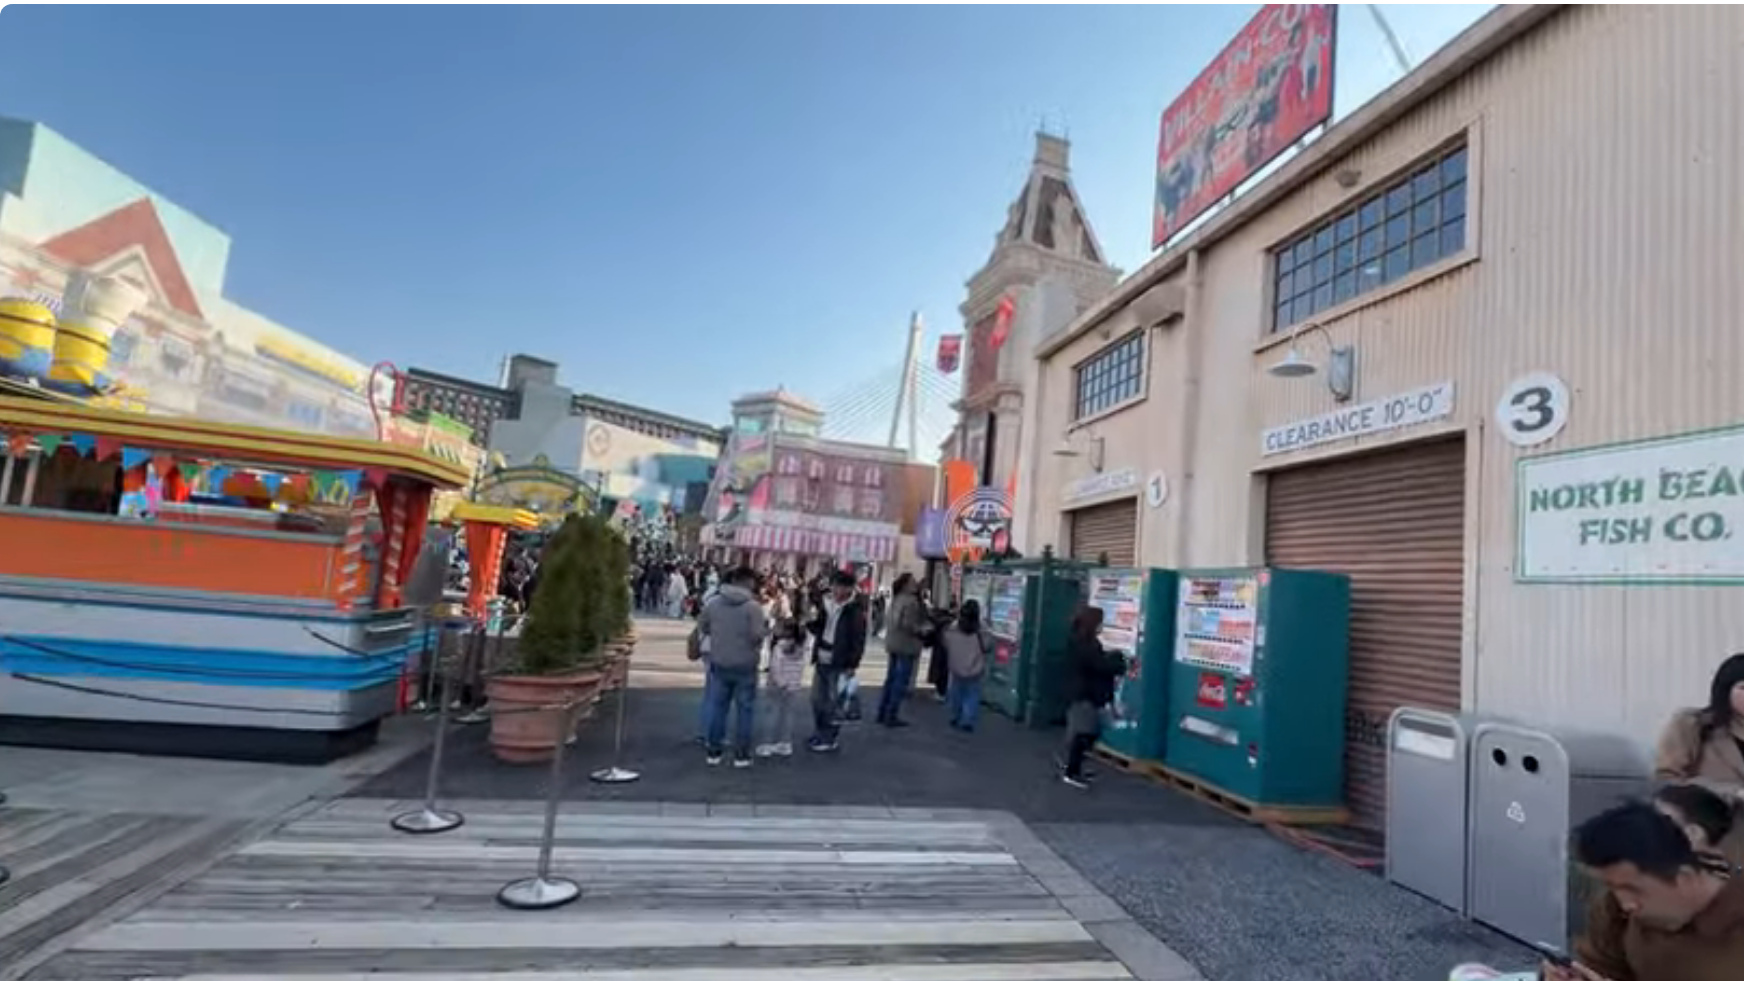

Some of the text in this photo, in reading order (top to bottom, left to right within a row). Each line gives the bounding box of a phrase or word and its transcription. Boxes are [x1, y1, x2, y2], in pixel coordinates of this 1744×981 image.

[1163, 4, 1329, 154] VILLAIN-CO
[1266, 406, 1374, 451] CLEARANCE
[1510, 387, 1555, 433] 3
[1530, 466, 1744, 513] NORTH BEA
[1579, 512, 1733, 546] FISH CO.
